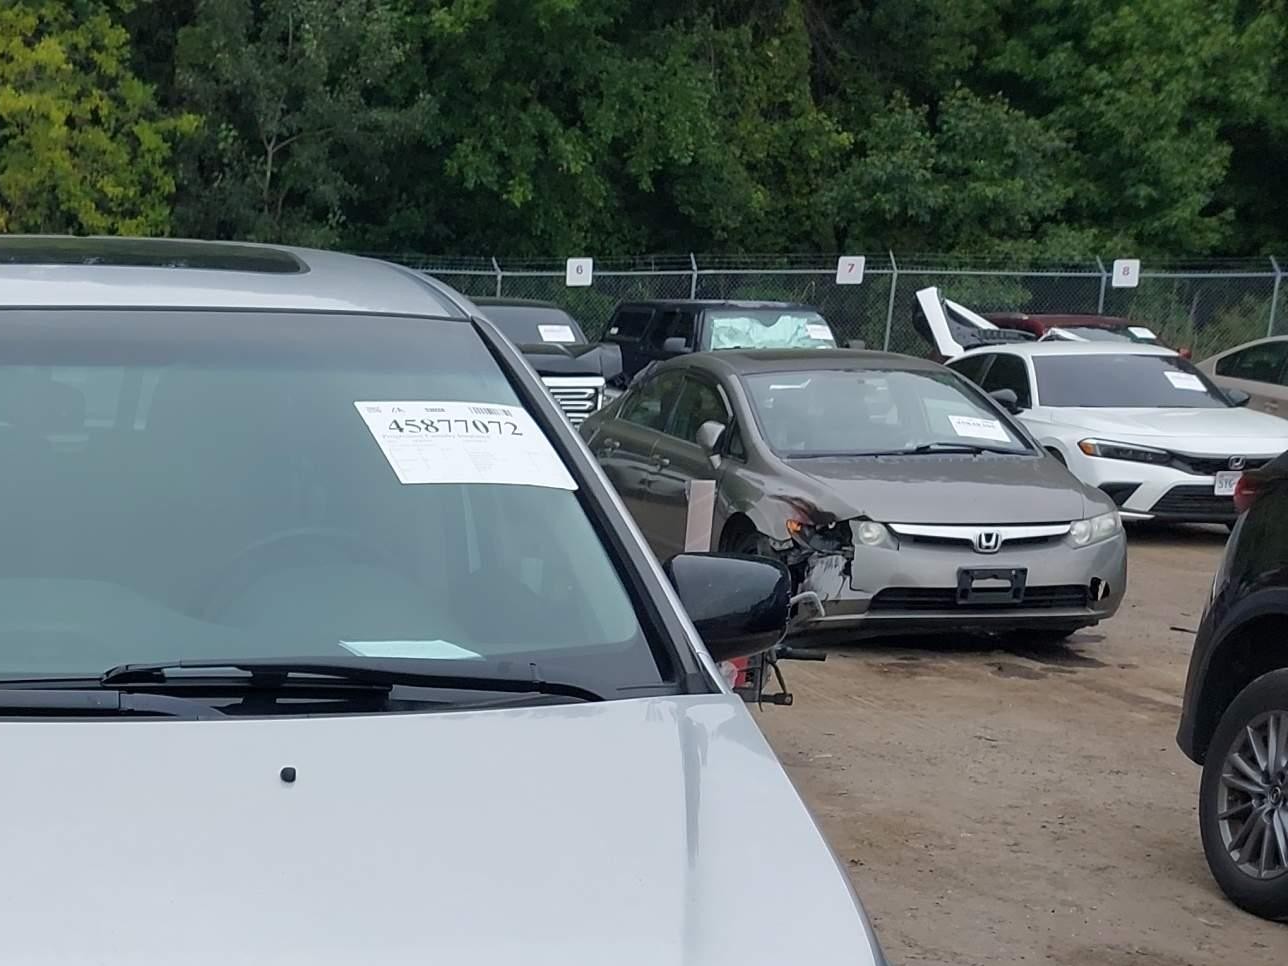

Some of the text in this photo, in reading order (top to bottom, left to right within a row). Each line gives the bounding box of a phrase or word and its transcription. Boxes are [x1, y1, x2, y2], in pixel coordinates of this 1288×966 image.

[575, 264, 584, 276] 6
[847, 263, 856, 273] 7
[1121, 266, 1130, 277] 8
[387, 418, 524, 437] 45877072
